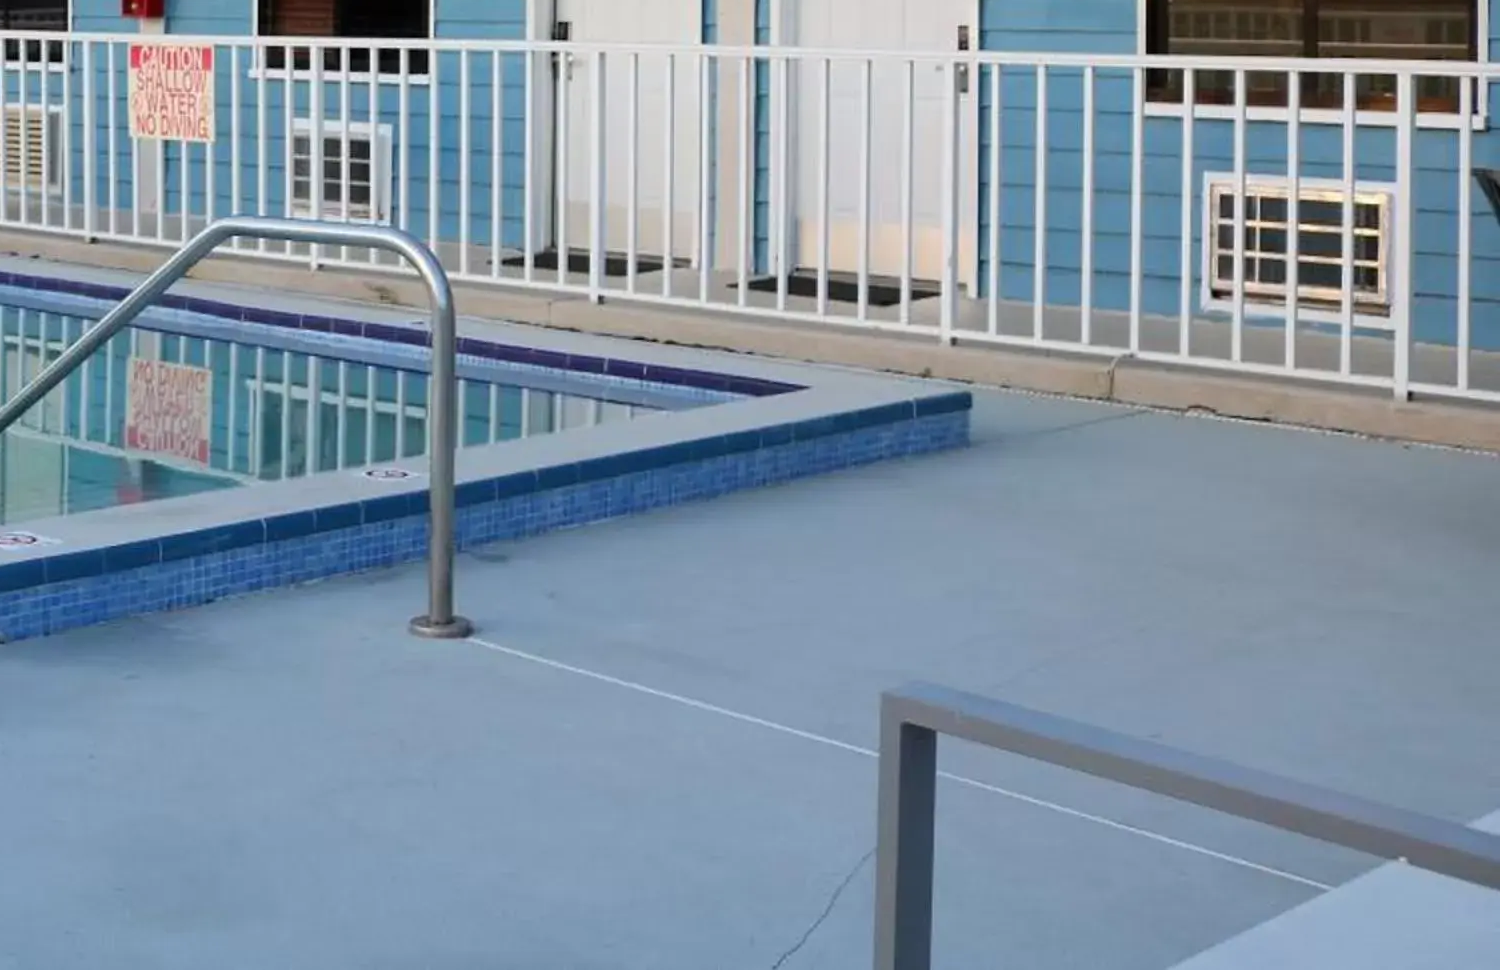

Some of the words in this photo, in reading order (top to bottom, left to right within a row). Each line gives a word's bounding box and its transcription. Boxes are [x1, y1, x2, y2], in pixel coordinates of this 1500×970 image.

[139, 43, 201, 70] CAUTION
[136, 70, 207, 93] SHALLOW
[144, 92, 197, 116] WATER
[136, 114, 156, 135] NO
[160, 116, 209, 140] DIVING
